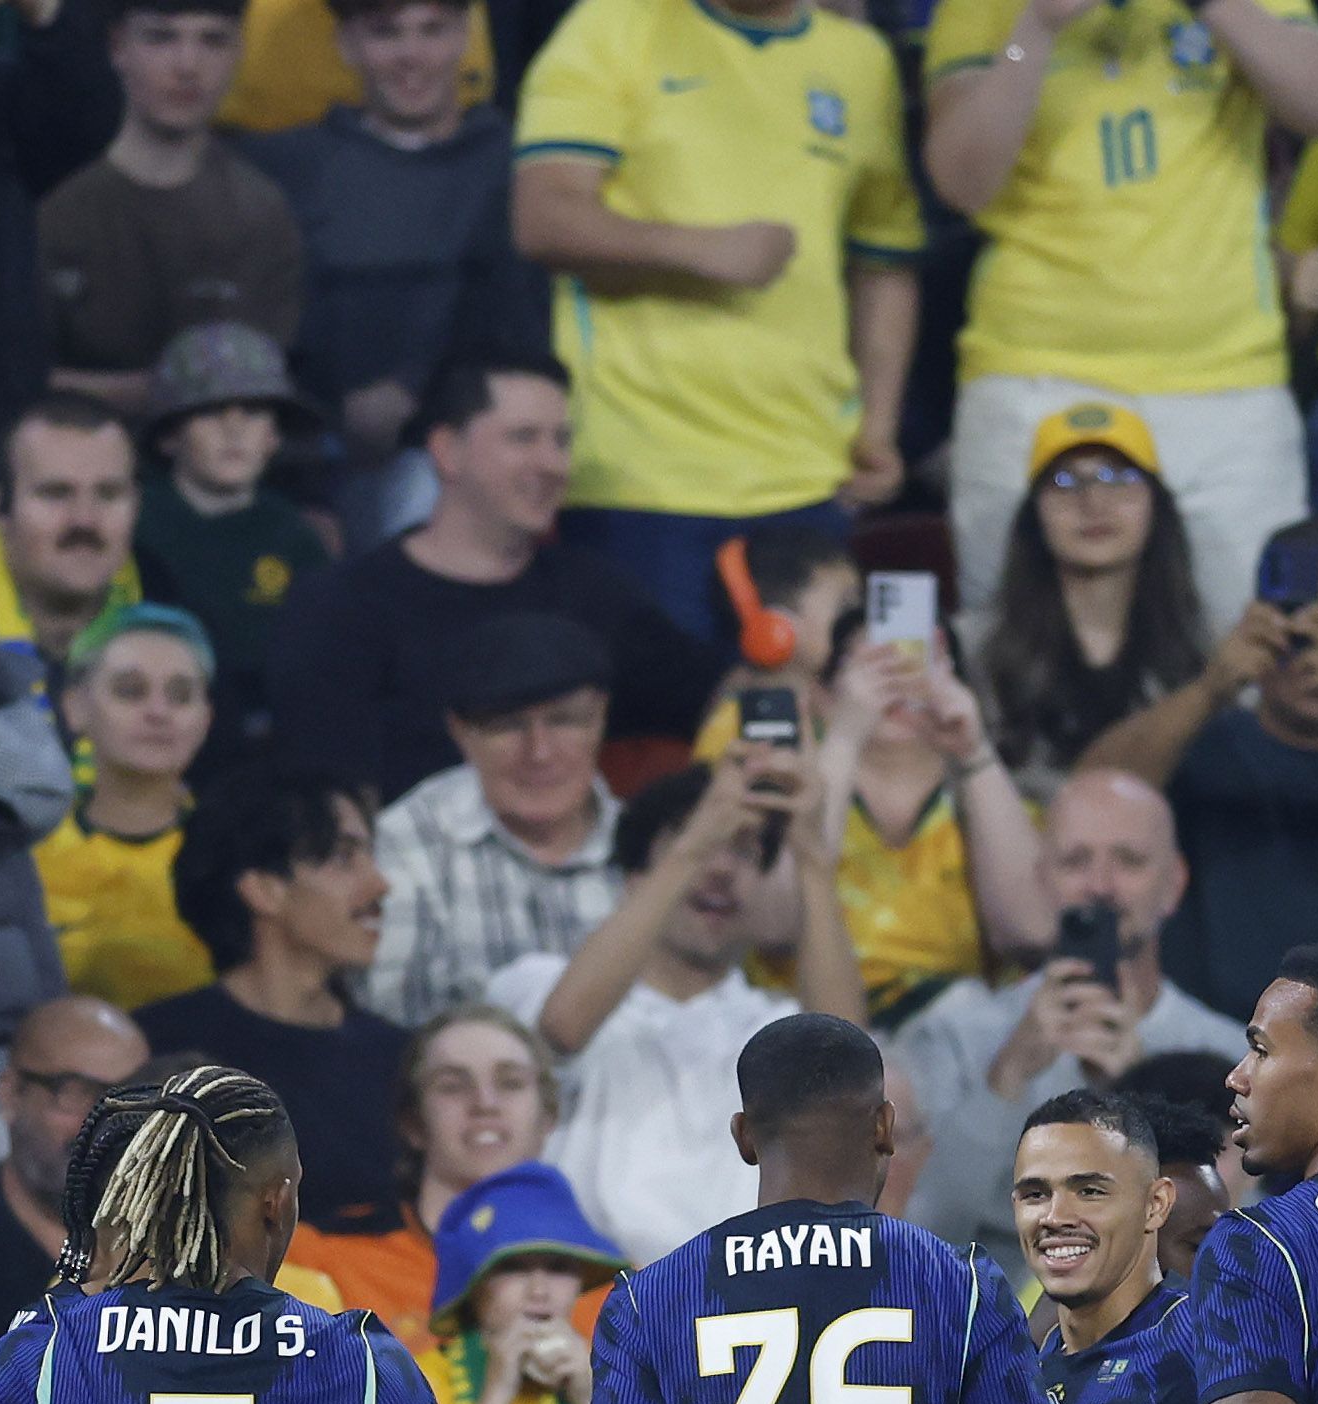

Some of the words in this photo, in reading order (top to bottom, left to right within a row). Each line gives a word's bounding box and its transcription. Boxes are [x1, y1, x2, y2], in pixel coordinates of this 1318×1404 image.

[1099, 108, 1157, 188] 10
[725, 1223, 872, 1277] RAYAN
[97, 1305, 262, 1356] DANILO
[276, 1313, 316, 1358] S.
